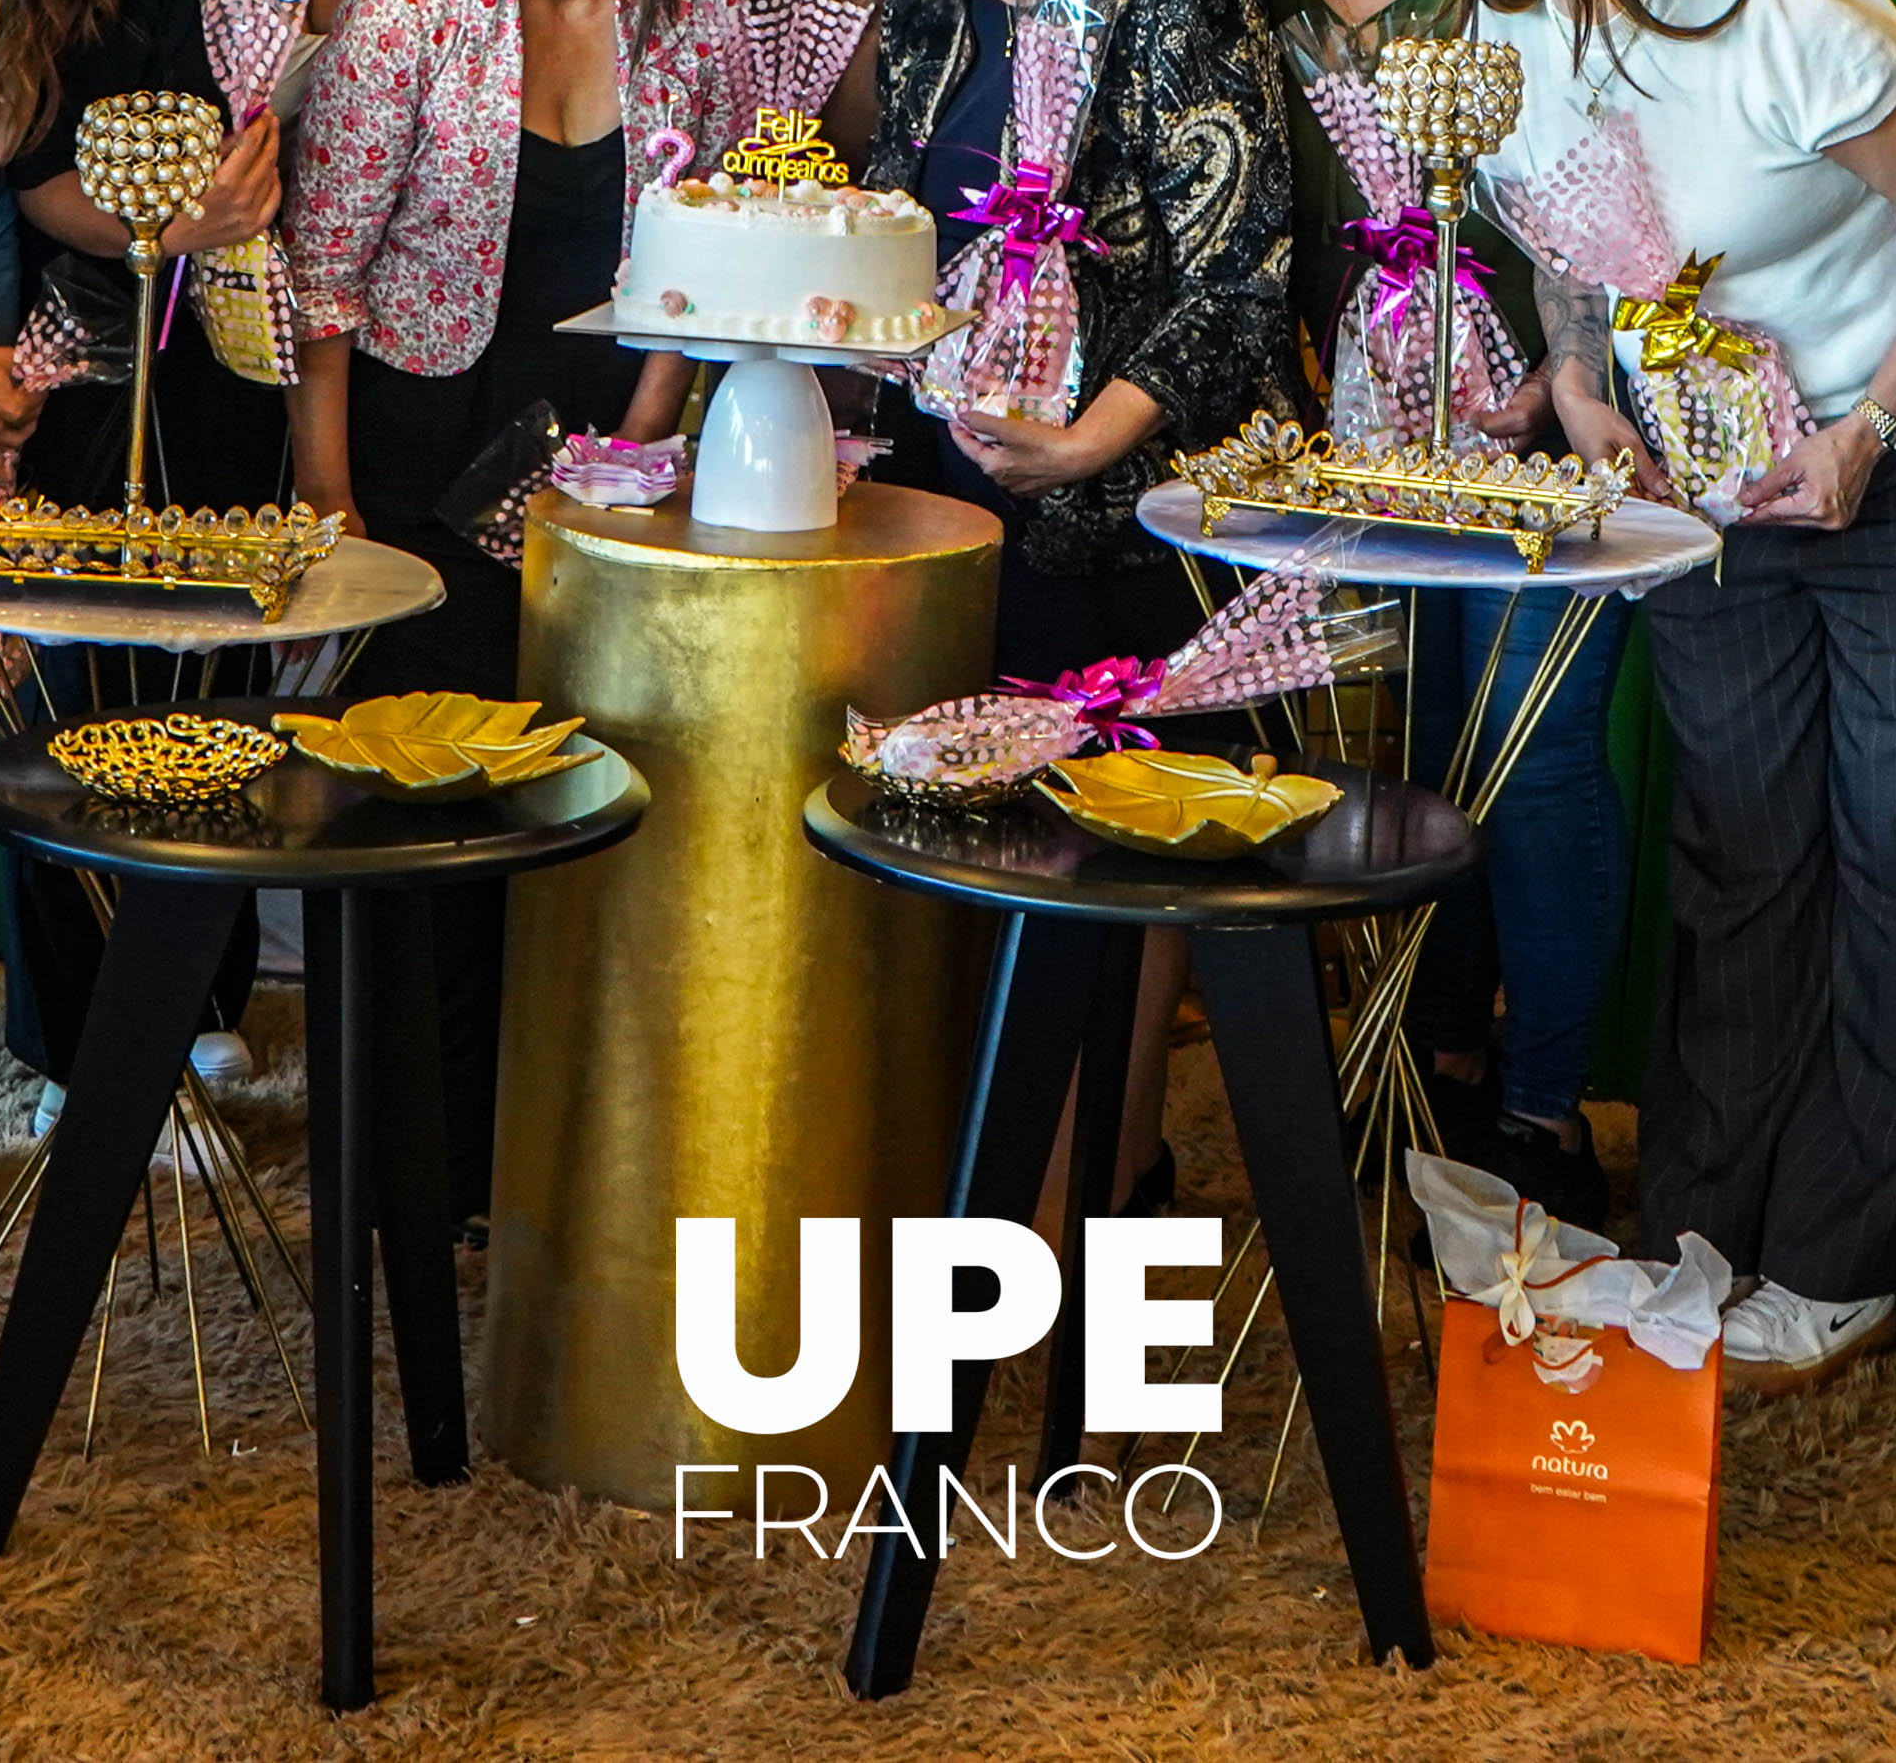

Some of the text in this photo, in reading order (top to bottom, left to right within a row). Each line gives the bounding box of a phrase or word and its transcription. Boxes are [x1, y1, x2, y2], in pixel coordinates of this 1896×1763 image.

[756, 107, 823, 143] Feliz
[722, 150, 849, 184] cumpleaños
[1532, 1455, 1608, 1480] natura
